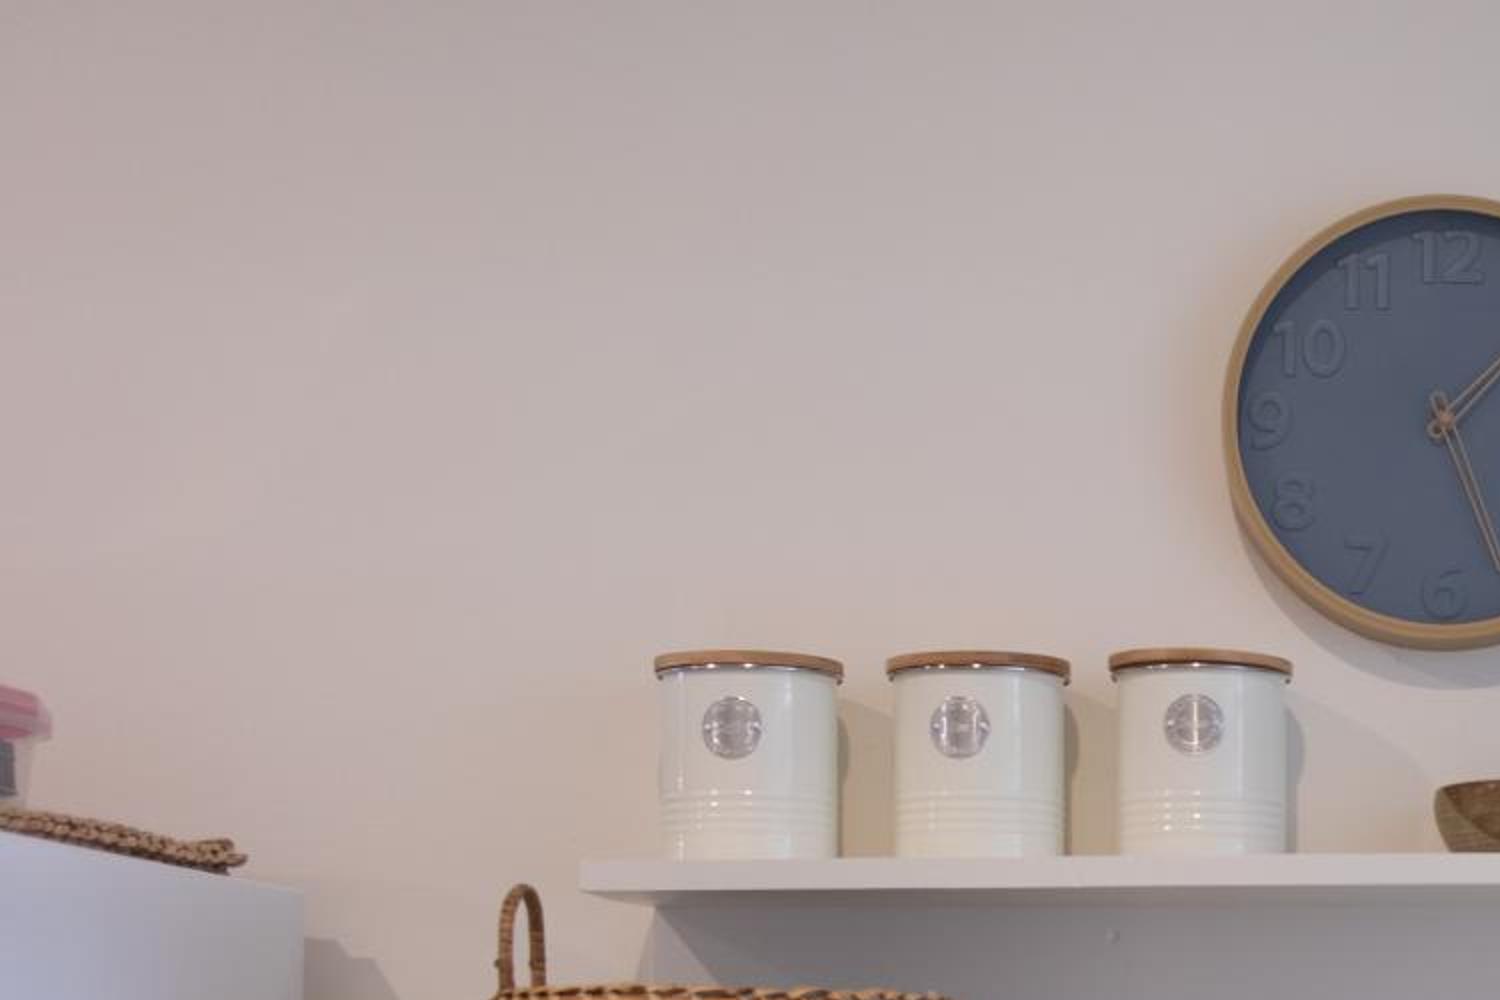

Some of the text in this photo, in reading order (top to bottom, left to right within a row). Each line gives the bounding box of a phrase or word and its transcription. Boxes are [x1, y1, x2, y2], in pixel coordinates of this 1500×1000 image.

[1339, 252, 1392, 311] 11
[1412, 230, 1483, 285] 12
[1274, 320, 1345, 378] 10
[1248, 392, 1287, 450] 9
[1273, 478, 1315, 532] 8
[1344, 539, 1389, 595] 7
[1421, 569, 1470, 618] 6
